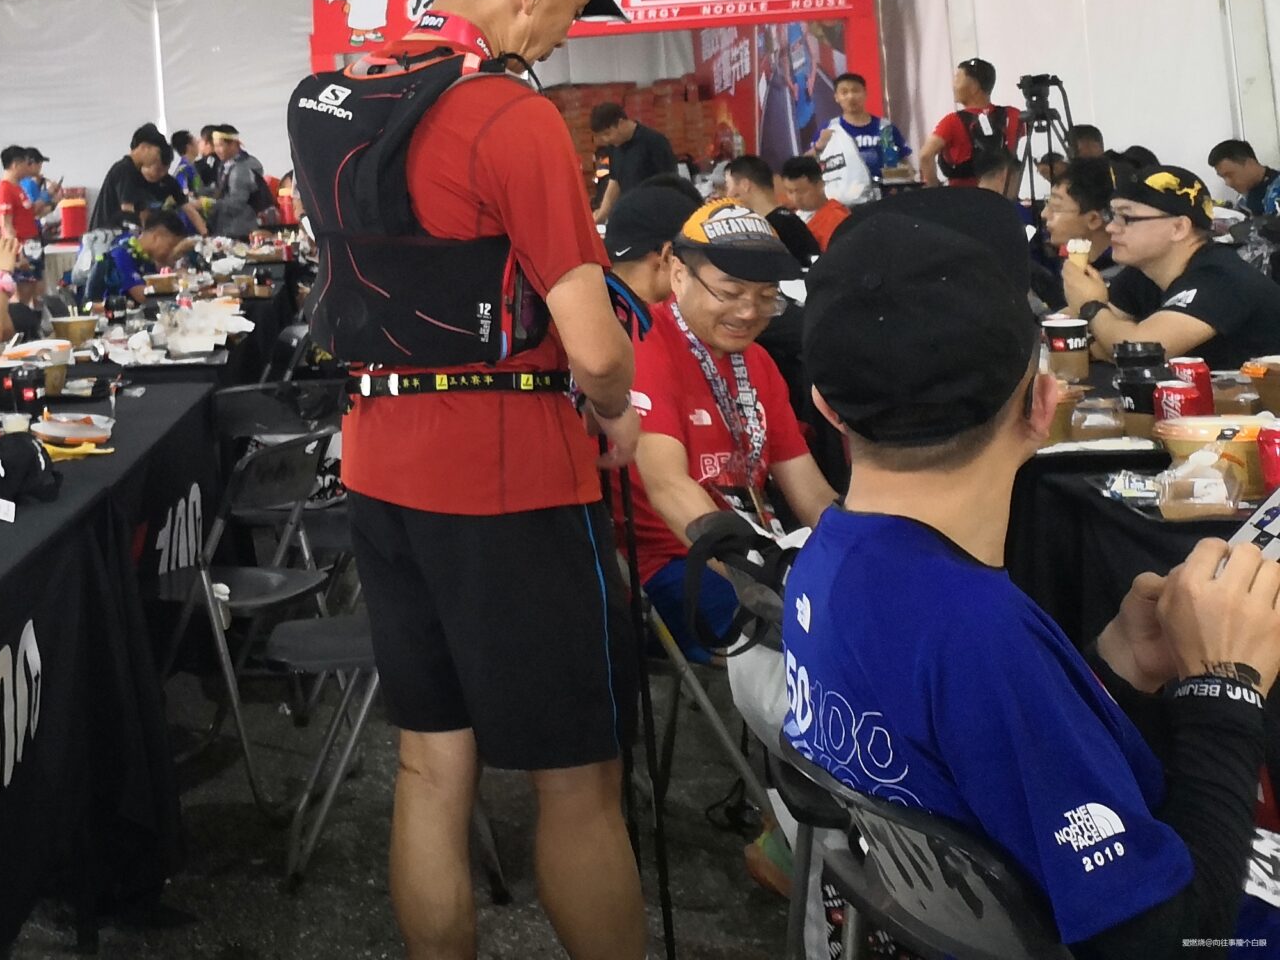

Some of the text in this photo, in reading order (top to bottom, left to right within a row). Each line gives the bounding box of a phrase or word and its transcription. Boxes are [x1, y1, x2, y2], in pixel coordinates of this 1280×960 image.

[624, 6, 681, 20] NERGY
[701, 0, 768, 16] NOODLE
[478, 302, 492, 316] 12
[155, 481, 203, 576] 100
[1175, 683, 1221, 698] BEIJIN
[1063, 804, 1091, 826] THE
[1054, 813, 1098, 846] NORTH
[1071, 829, 1103, 853] FACE
[1081, 841, 1125, 873] 2019
